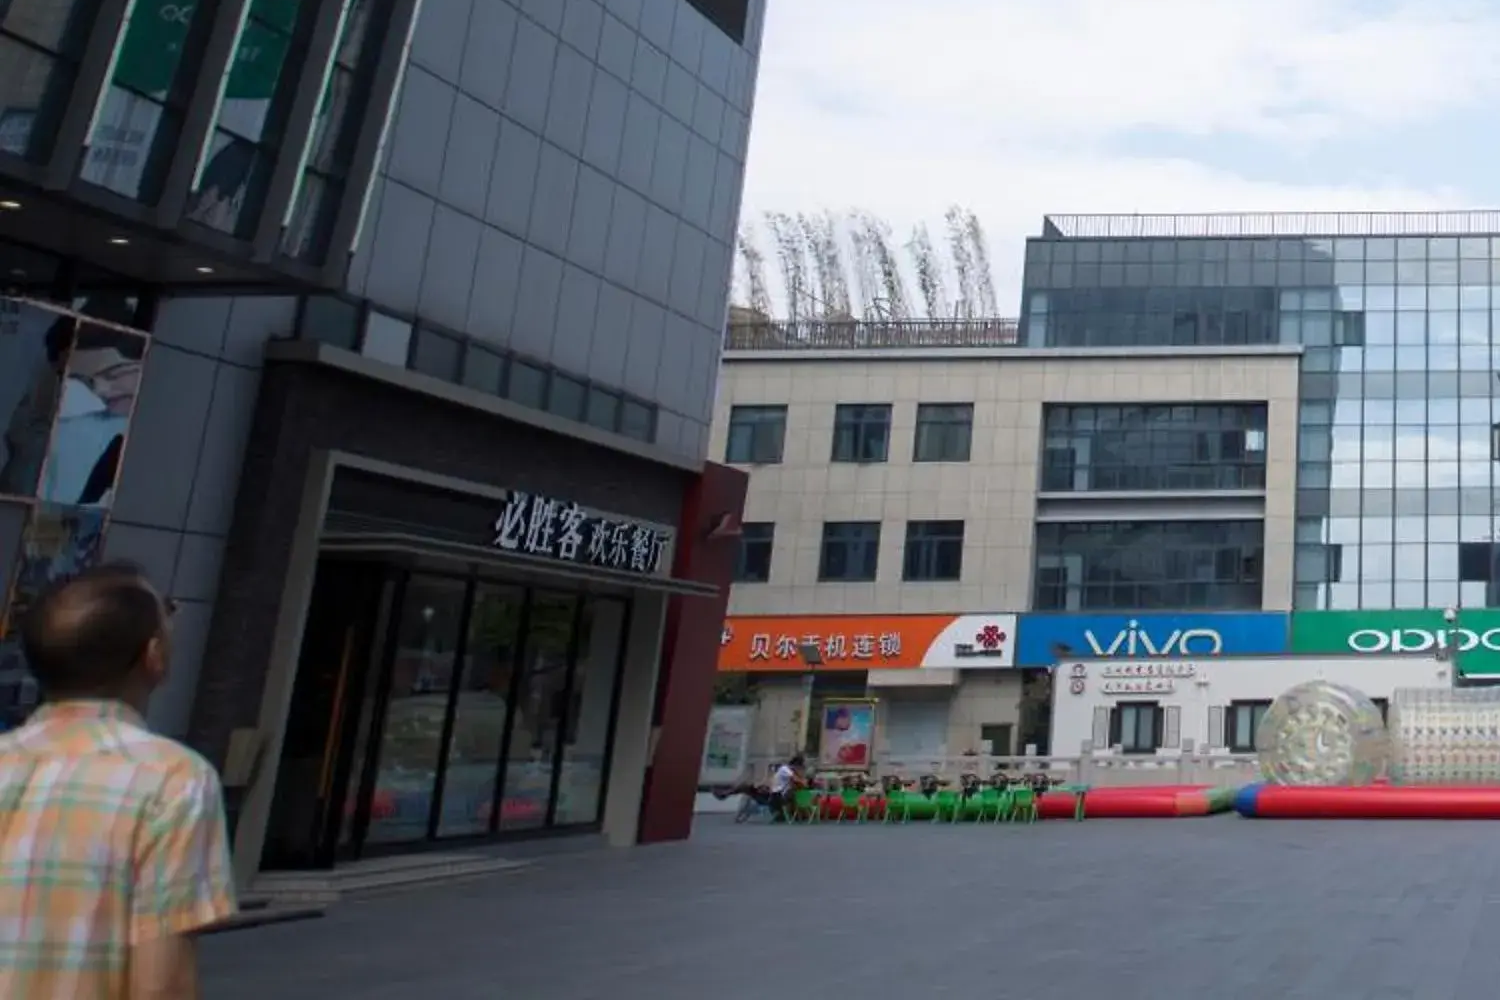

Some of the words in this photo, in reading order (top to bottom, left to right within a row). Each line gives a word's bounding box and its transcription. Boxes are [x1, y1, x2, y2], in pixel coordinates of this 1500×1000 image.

[495, 492, 586, 559] 必胜客
[587, 519, 670, 573] 欢乐餐厅
